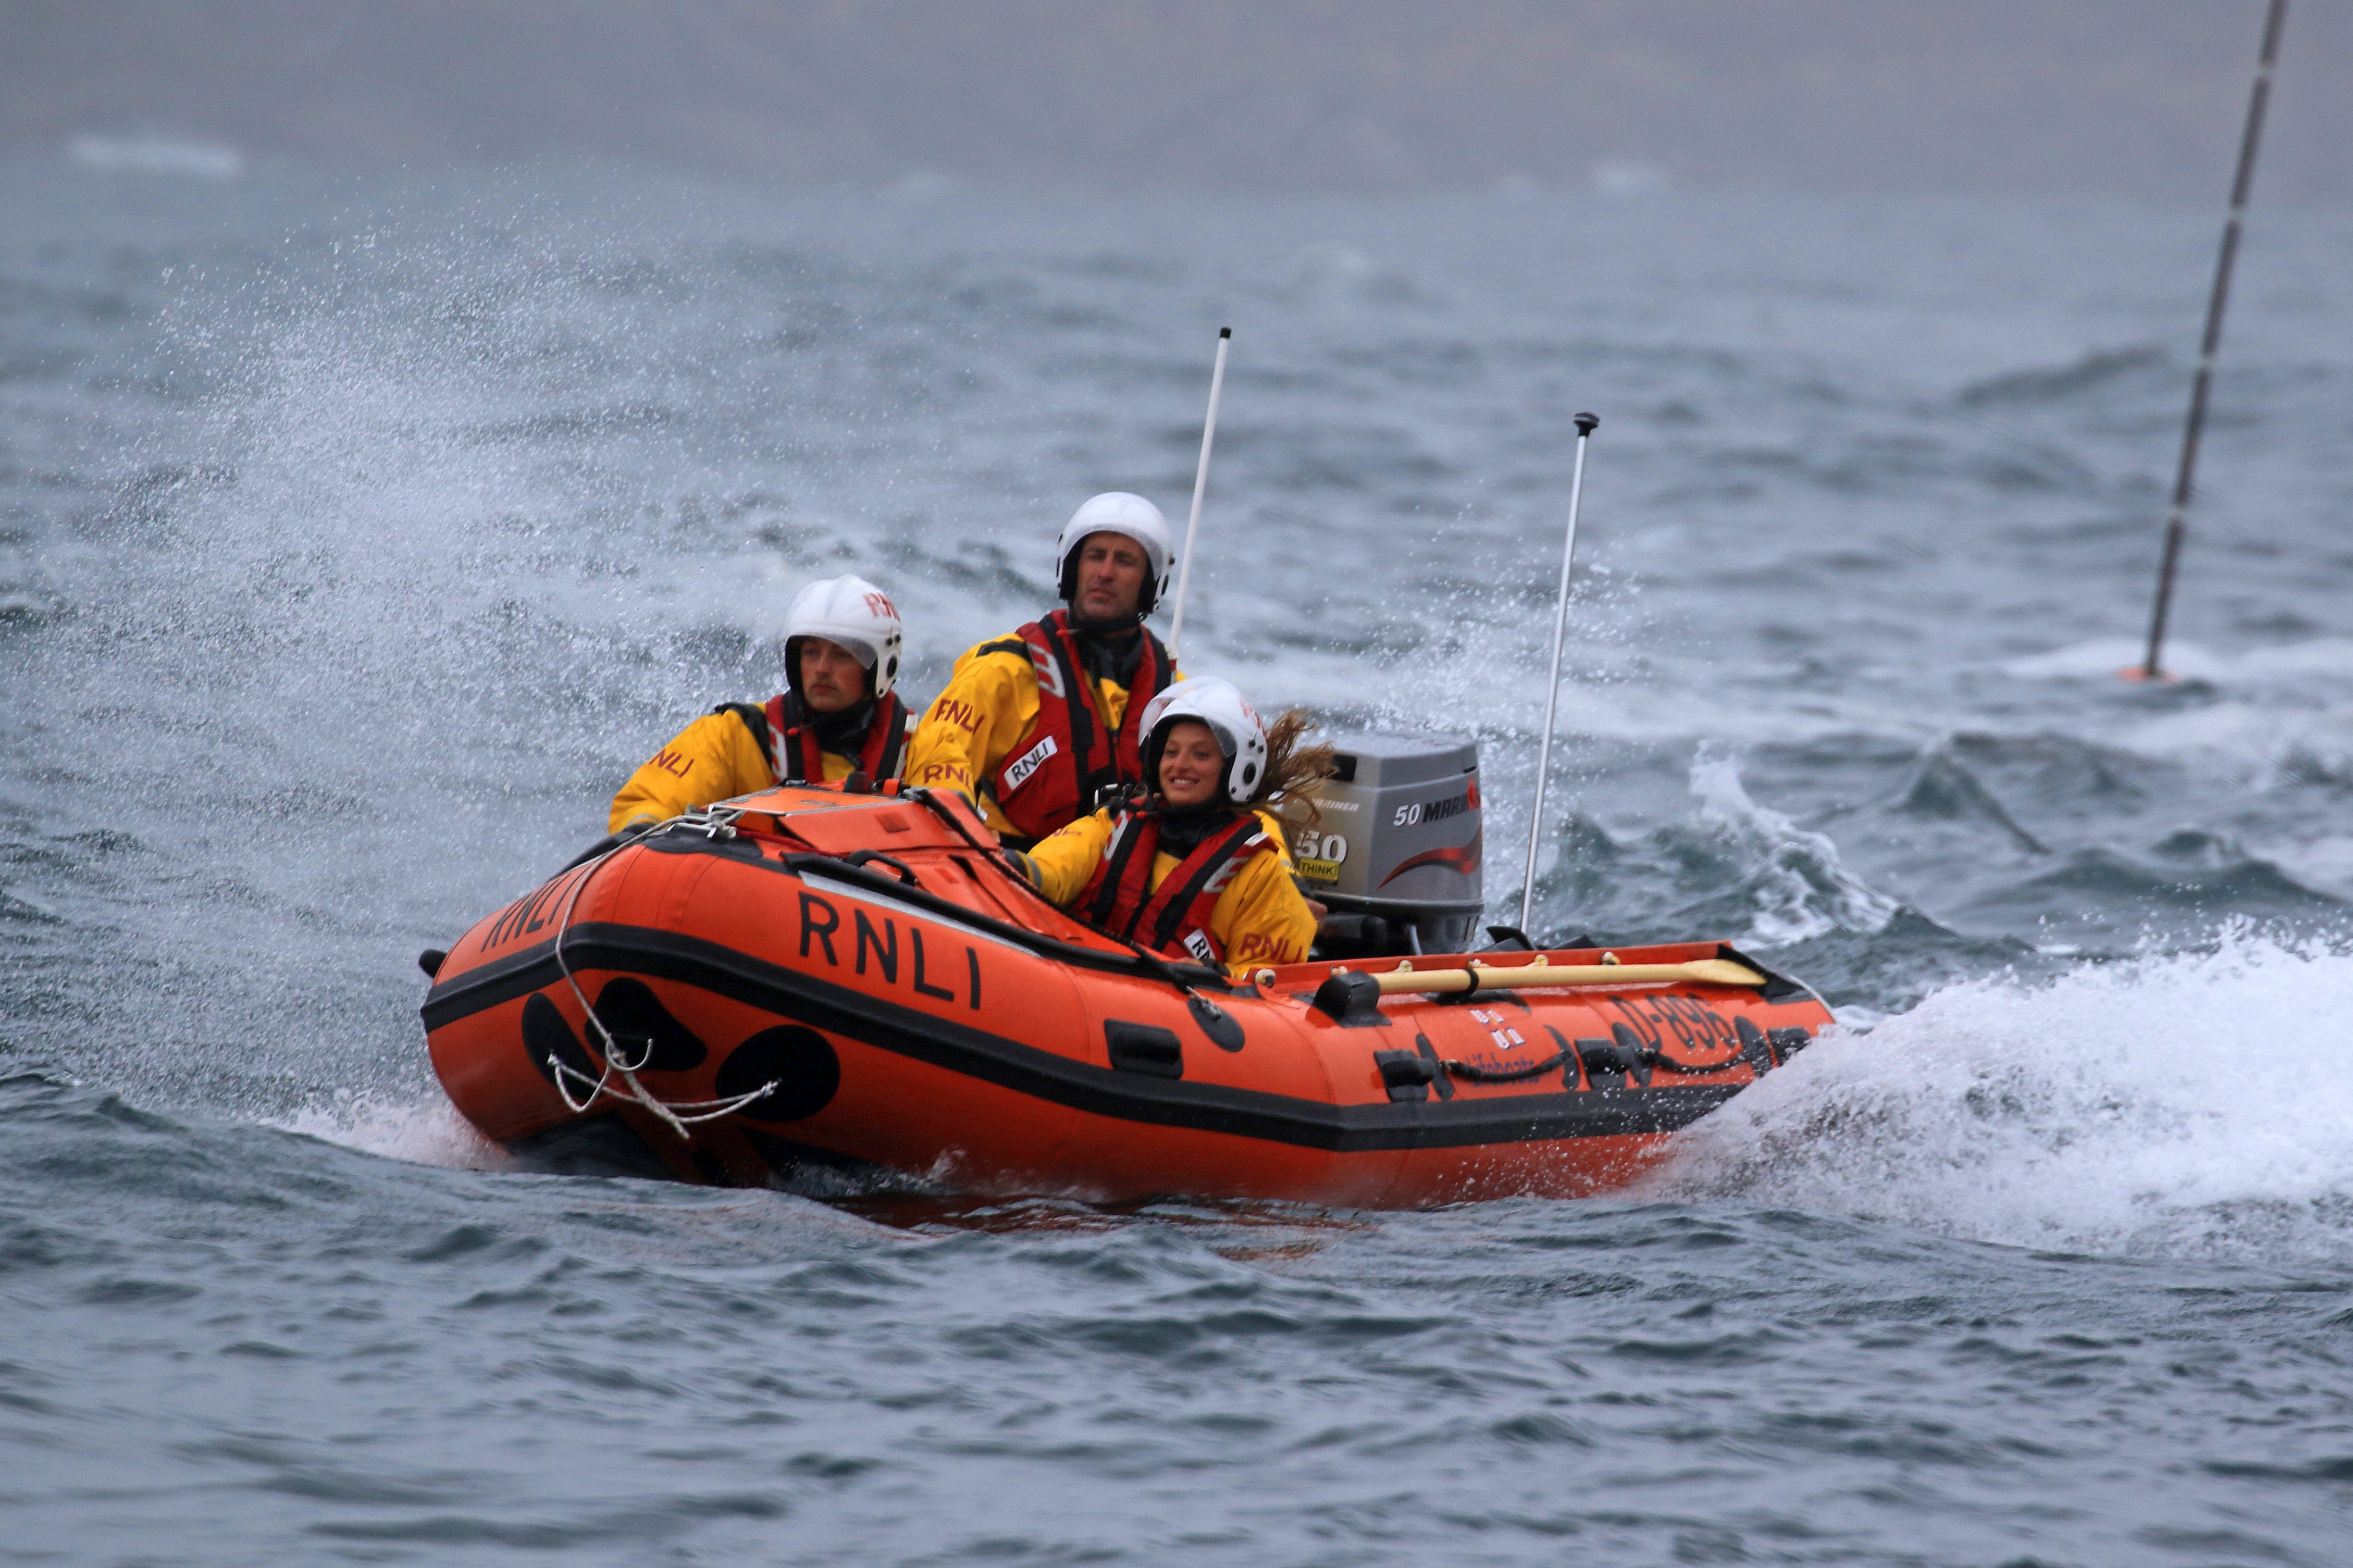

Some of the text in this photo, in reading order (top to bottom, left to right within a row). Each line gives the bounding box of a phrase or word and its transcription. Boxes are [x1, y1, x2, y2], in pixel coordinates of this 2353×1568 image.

[1011, 742, 1048, 781] RNLI
[1393, 803, 1421, 826] 50
[1295, 829, 1348, 863] 50
[480, 864, 593, 953] RNLI
[798, 891, 981, 1010] RNLI
[1239, 932, 1303, 964] RNLI
[1606, 992, 1736, 1051] D-896
